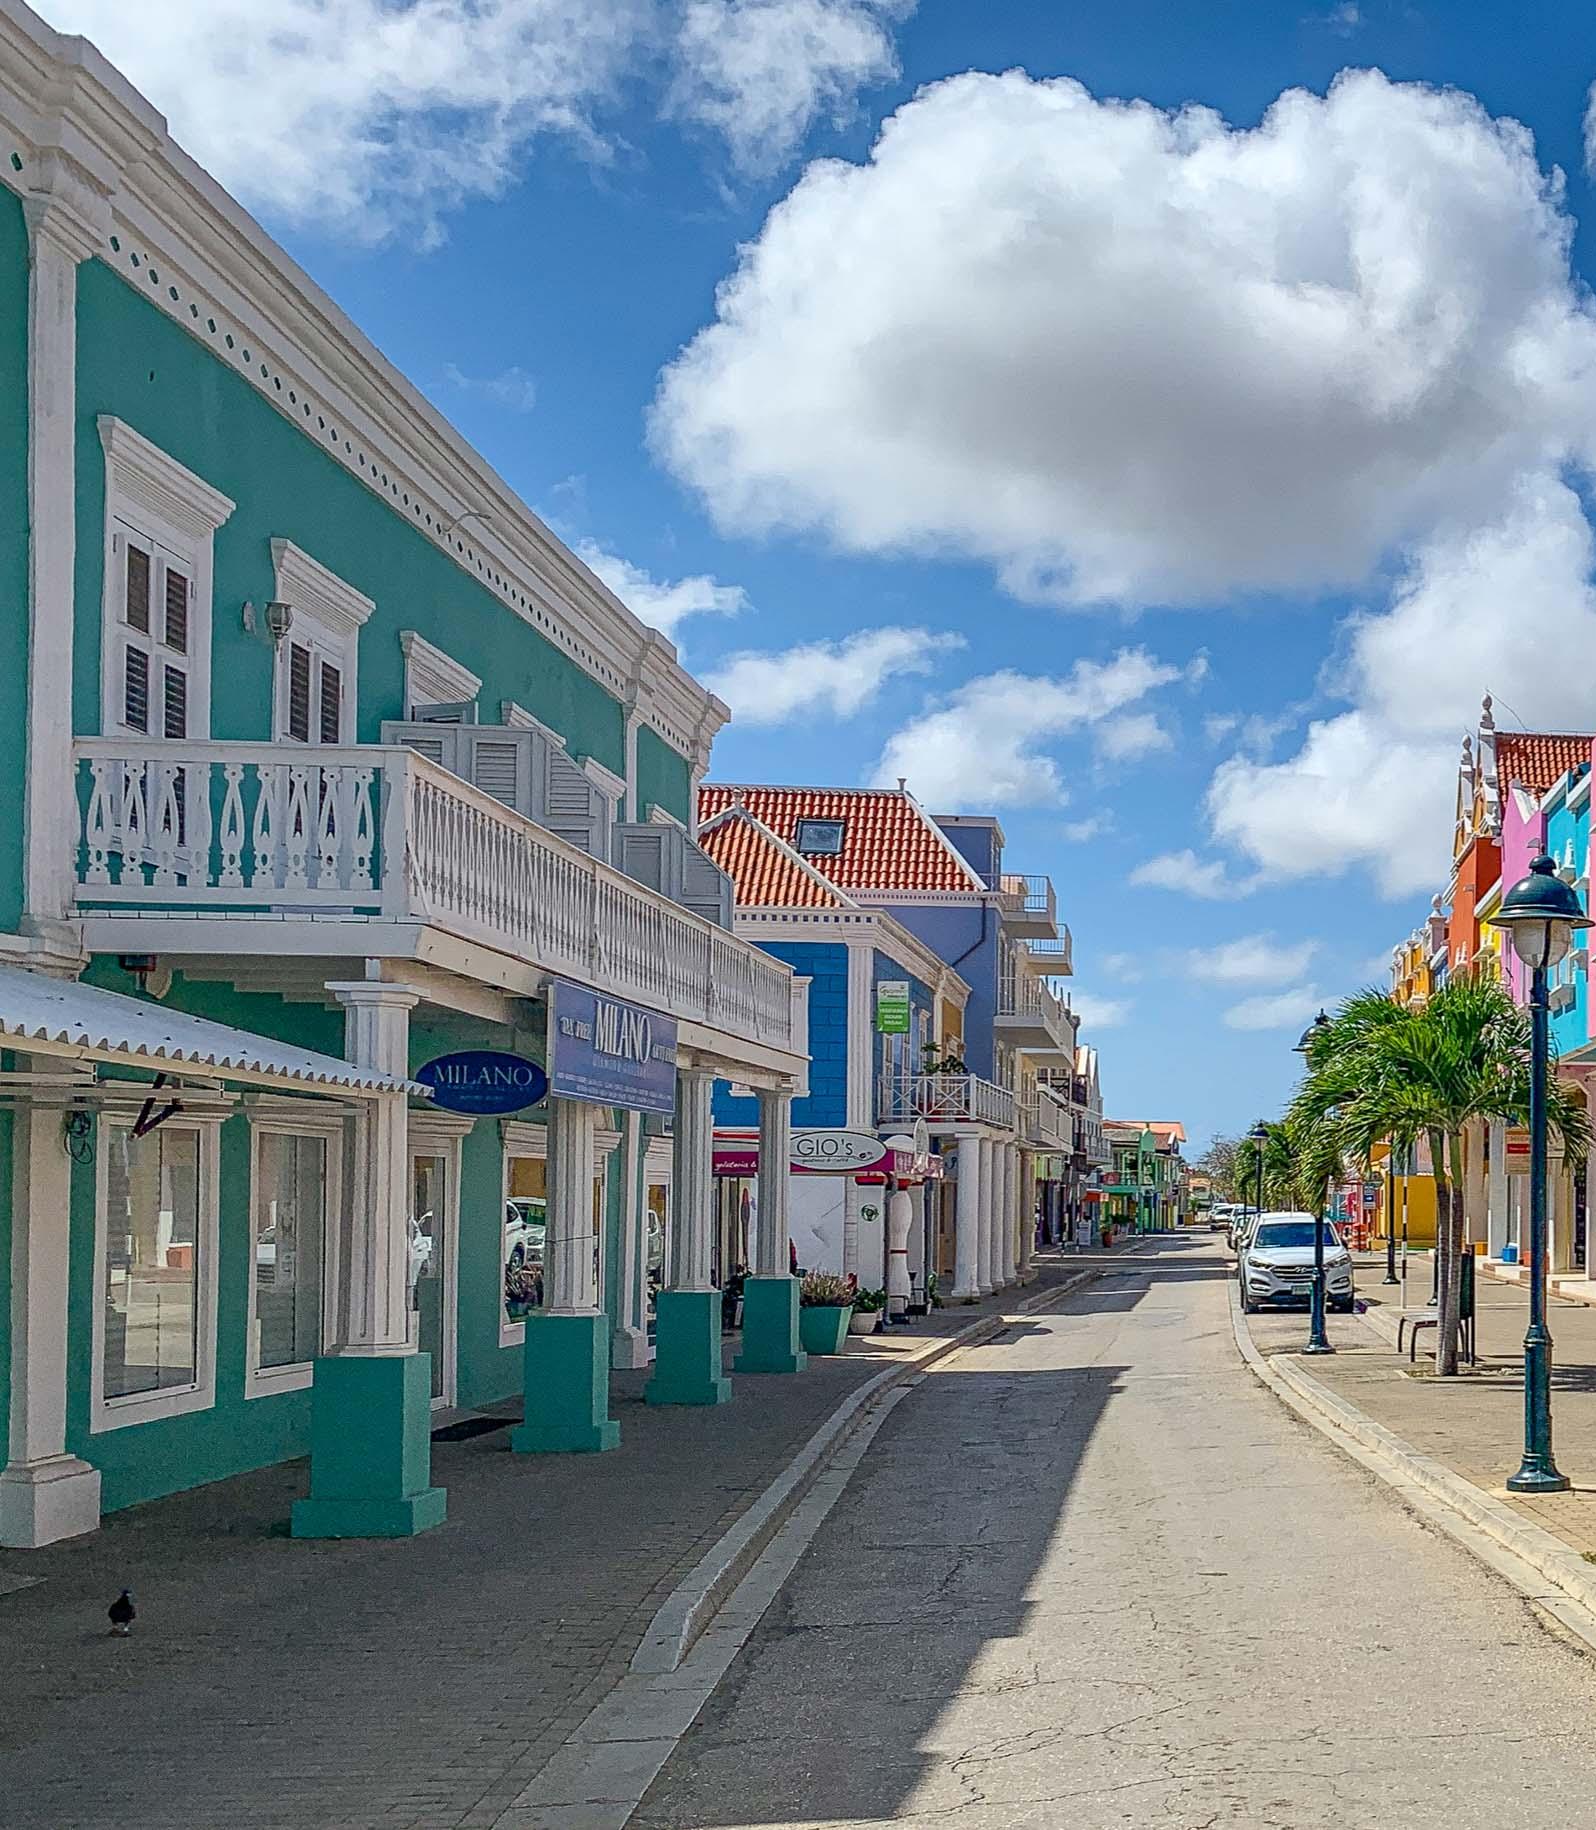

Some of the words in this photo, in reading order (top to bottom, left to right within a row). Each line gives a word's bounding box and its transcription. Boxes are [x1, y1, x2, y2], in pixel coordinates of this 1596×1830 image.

[595, 1000, 651, 1064] MILANO
[434, 1065, 533, 1087] MILANO
[796, 1138, 853, 1156] GIO's
